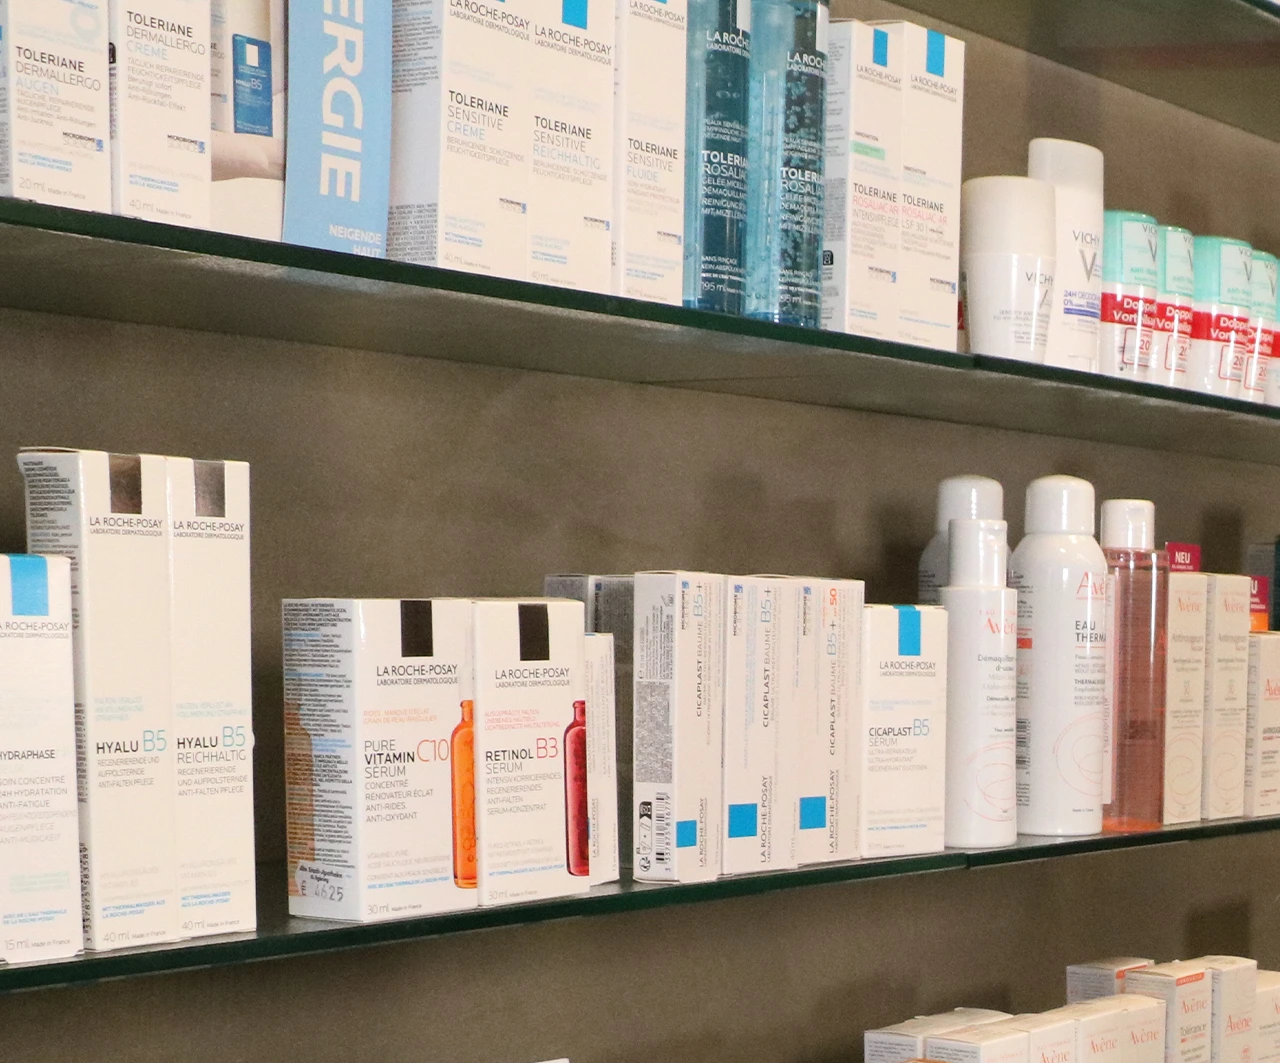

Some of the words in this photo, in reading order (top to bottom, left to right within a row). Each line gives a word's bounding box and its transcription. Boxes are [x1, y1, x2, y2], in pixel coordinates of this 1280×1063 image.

[127, 10, 193, 37] TOLERIANE
[127, 26, 205, 55] DERMALLERGO
[535, 25, 546, 37] LA
[548, 28, 611, 55] ROCHE-POSAY
[16, 46, 85, 73] TOLERIANE
[127, 43, 168, 60] CREME
[16, 62, 100, 91] DERMALLERGO
[16, 79, 59, 95] AUGEN
[449, 90, 508, 118] TOLERIANE
[448, 106, 503, 131] SENSITIVE
[535, 116, 591, 139] TOLERIANE
[447, 121, 485, 140] CREME
[534, 130, 586, 152] SENSITIVE
[628, 138, 678, 159] TOLERIANE
[533, 146, 600, 170] REICHHALTIG
[628, 152, 673, 172] SENSITIVE
[627, 166, 659, 182] FLUIDE
[853, 183, 897, 203] TOLERIANE
[902, 193, 944, 213] TOLERIANE
[329, 224, 381, 245] NEIGENDE
[1072, 230, 1101, 246] VICHY
[90, 517, 100, 526] LA
[104, 518, 163, 528] ROCHE-POSAY
[174, 521, 184, 530] LA
[187, 522, 244, 531] ROCHE-POSAY
[1175, 552, 1191, 564] NEU
[5, 622, 69, 631] ROCHE-POSAY
[1075, 620, 1096, 631] EAU
[376, 666, 389, 677] LA
[391, 664, 458, 676] ROCHE-POSAY
[495, 669, 508, 680] LA
[509, 668, 570, 679] ROCHE-POSAY
[879, 661, 889, 670] LA
[890, 661, 936, 670] ROCHE-POSAY
[762, 666, 770, 728] CICAPLAST
[177, 736, 218, 749] HYALU
[222, 726, 246, 747] B5
[869, 727, 912, 737] CICAPLAST
[913, 719, 929, 736] B5
[97, 741, 138, 754] HYALU
[143, 730, 167, 751] B5
[365, 740, 396, 751] PURE
[365, 752, 415, 765] VITAMIN
[417, 739, 449, 762] C10
[486, 749, 534, 762] RETINOL
[536, 738, 558, 758] B3
[177, 749, 246, 763] REICHHALTIG
[486, 762, 523, 774] SERUM
[760, 775, 769, 845] ROCHE-POSAY
[329, 885, 344, 901] 25
[1089, 1037, 1117, 1054] Avène
[1129, 1027, 1159, 1045] Avène
